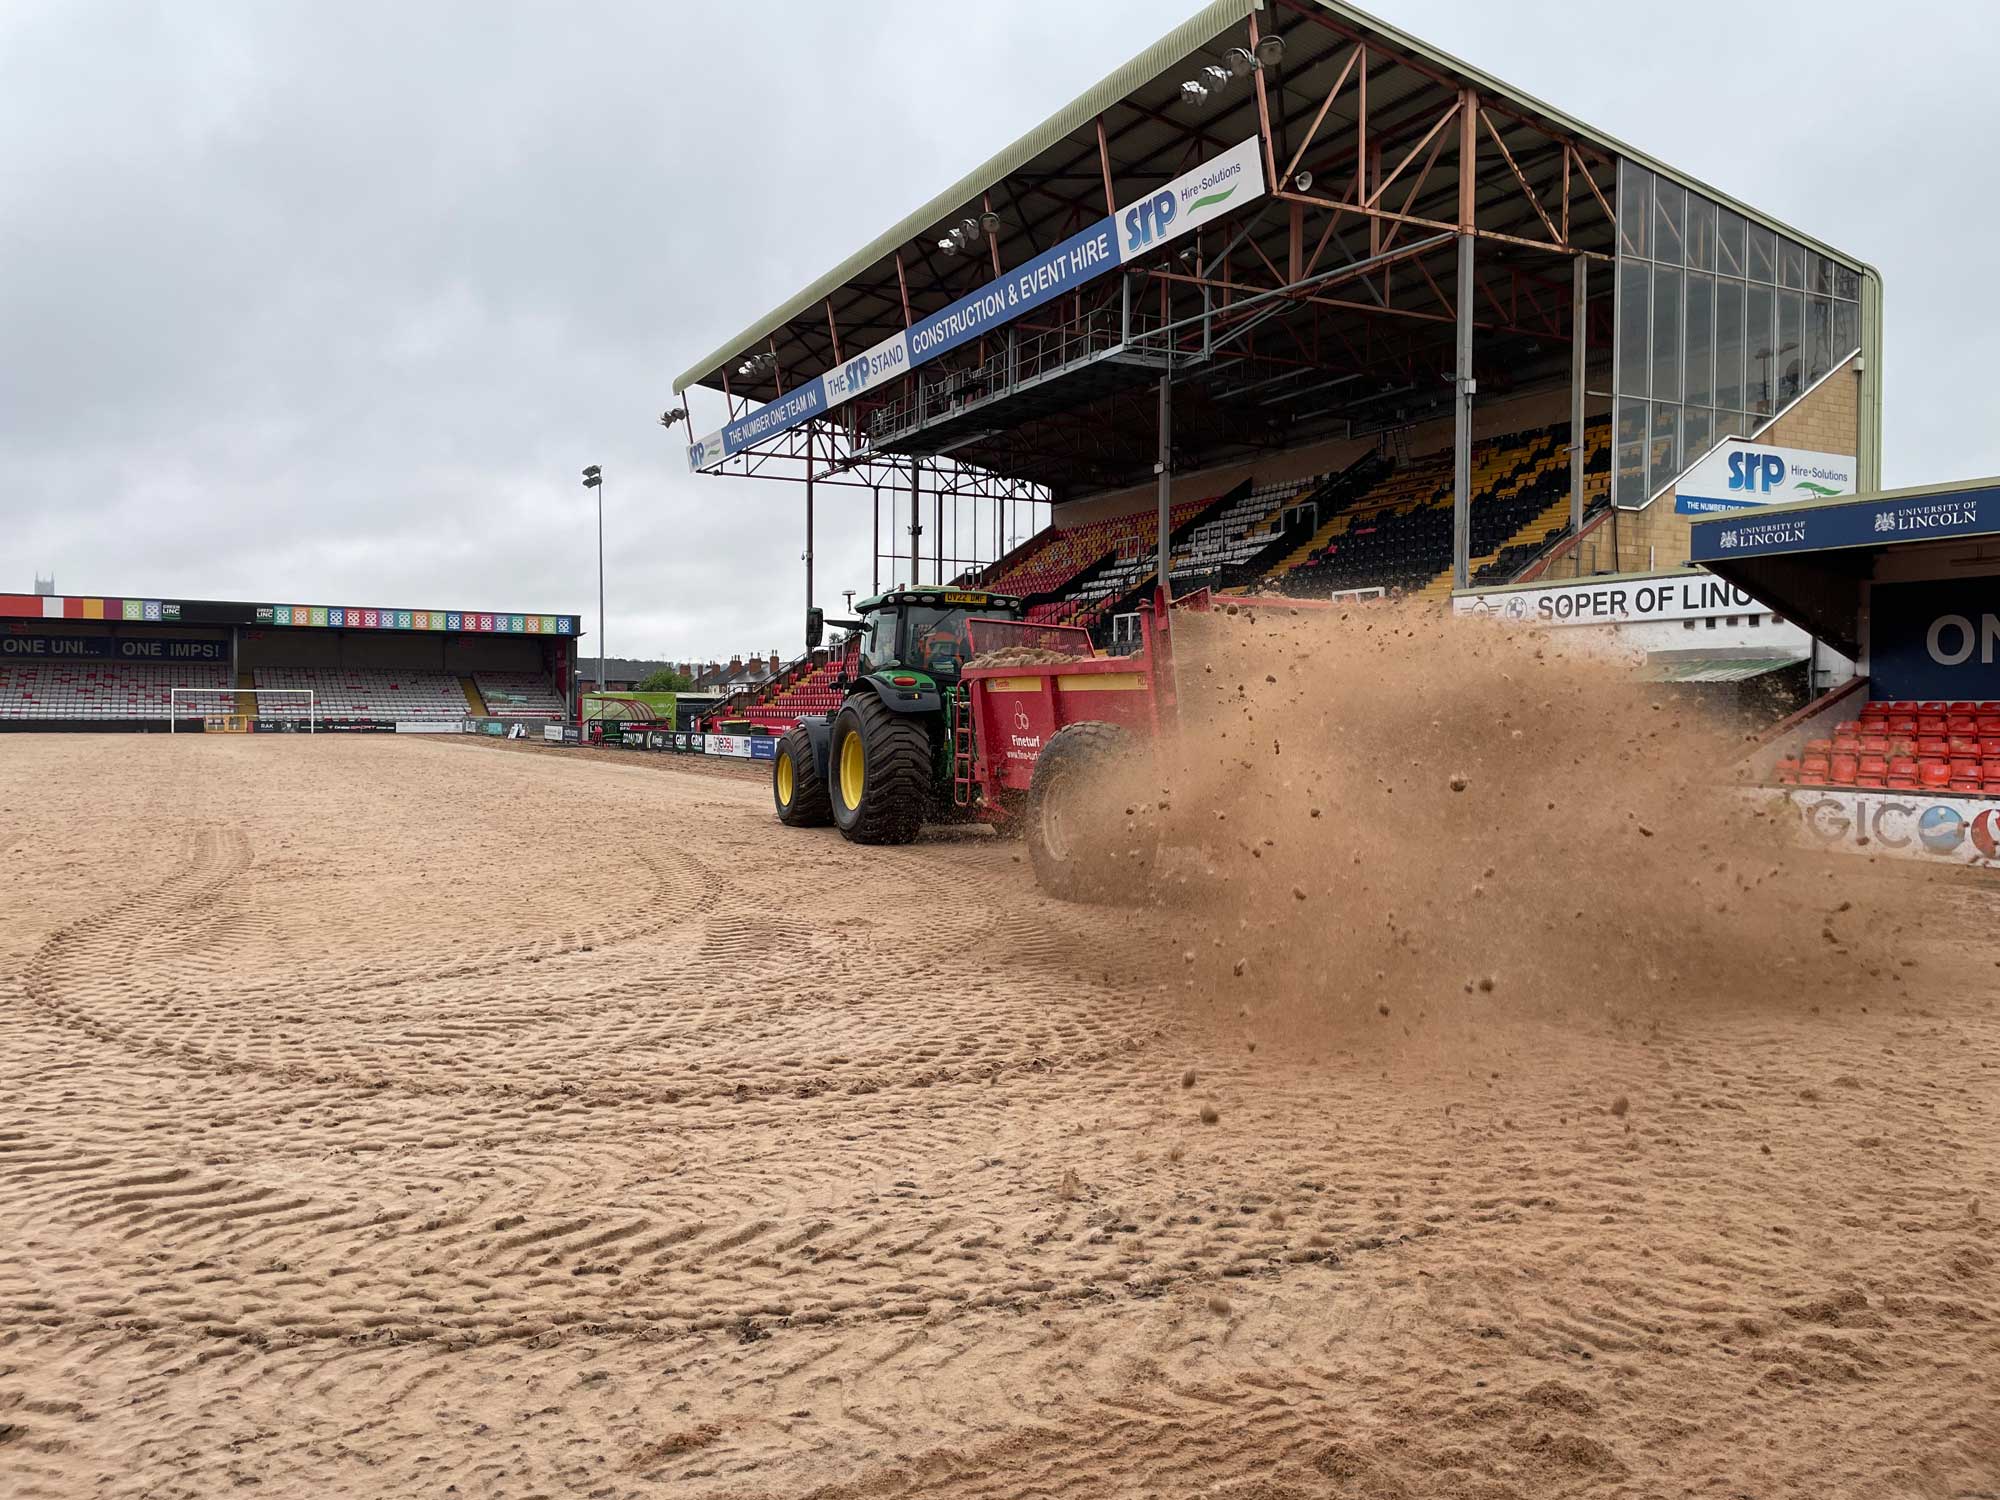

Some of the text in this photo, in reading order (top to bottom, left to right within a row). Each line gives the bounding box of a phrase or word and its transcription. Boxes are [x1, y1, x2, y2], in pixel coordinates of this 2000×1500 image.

[912, 233, 1110, 354] CONSTRUCTION & EVENT HIRE
[828, 374, 846, 396] THE
[871, 344, 904, 376] STAND
[728, 427, 743, 446] THE
[742, 413, 770, 440] NUMBER
[770, 405, 787, 426] ONE
[786, 394, 808, 418] TEAM
[807, 389, 817, 407] IN
[1686, 501, 1700, 510] THE
[1700, 503, 1726, 512] NUMBER
[1898, 501, 1977, 517] UNIVERSITY OF
[1740, 521, 1806, 535] UNIVERSITY OF
[1898, 510, 1977, 530] LINCOLN
[1740, 529, 1806, 547] LINCOLN
[1539, 590, 1628, 619] SOPER
[1635, 586, 1674, 613] OF
[2, 639, 45, 654] ONE
[122, 642, 220, 658] ONE IMPS!
[1012, 735, 1040, 748] Fineturf
